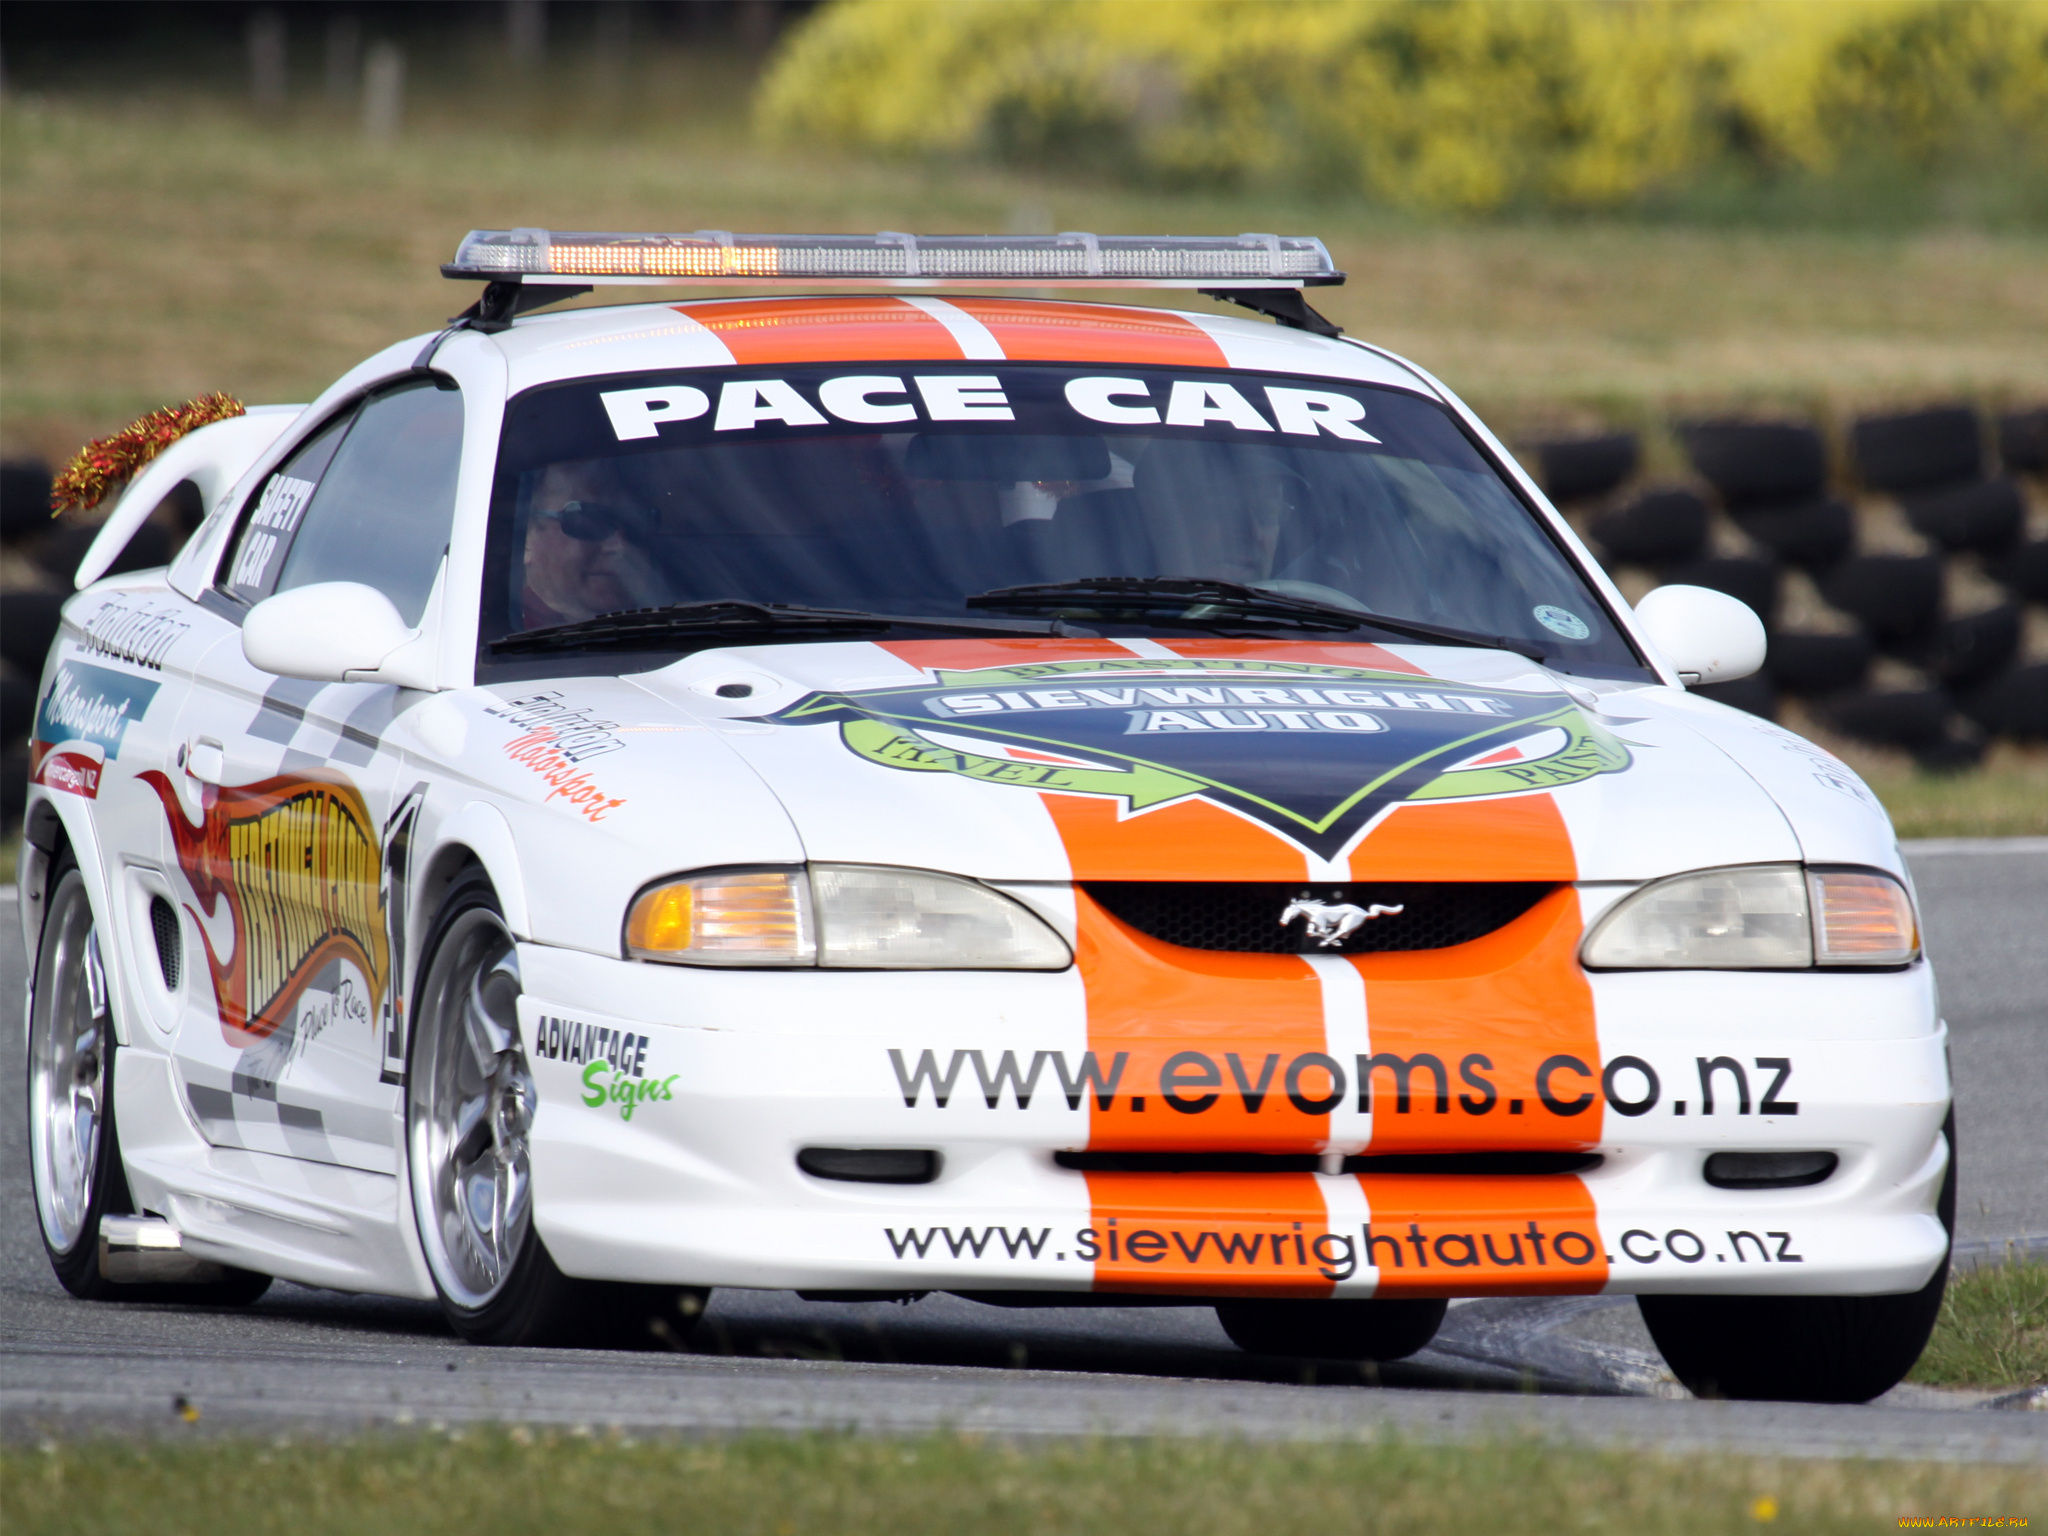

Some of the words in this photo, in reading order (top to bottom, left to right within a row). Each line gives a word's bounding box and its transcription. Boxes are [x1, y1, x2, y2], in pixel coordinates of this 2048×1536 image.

[600, 375, 1017, 441] PACE
[1064, 376, 1382, 445] CAR
[250, 473, 316, 532] SAFETY
[236, 531, 277, 588] CAR
[1004, 659, 1366, 679] BLASTING
[46, 667, 131, 742] Motorsport
[932, 686, 1507, 717] SIEVWRIGHT
[1136, 710, 1386, 735] AUTO
[46, 760, 87, 790] ercargill
[85, 769, 97, 790] NZ
[502, 726, 627, 823] Motorsport
[874, 734, 1074, 787] PANEL
[1496, 736, 1622, 786] PAINT
[228, 789, 328, 1026] TERETONGA
[326, 793, 378, 978] PARK
[300, 1003, 329, 1058] Place
[340, 978, 368, 1025] Race
[535, 1015, 649, 1078] ADVANTAGE
[581, 1060, 681, 1121] Signs
[888, 1048, 1799, 1117] www.evoms.co.nz
[885, 1217, 1803, 1281] www.sievwrightauto.co.nz
